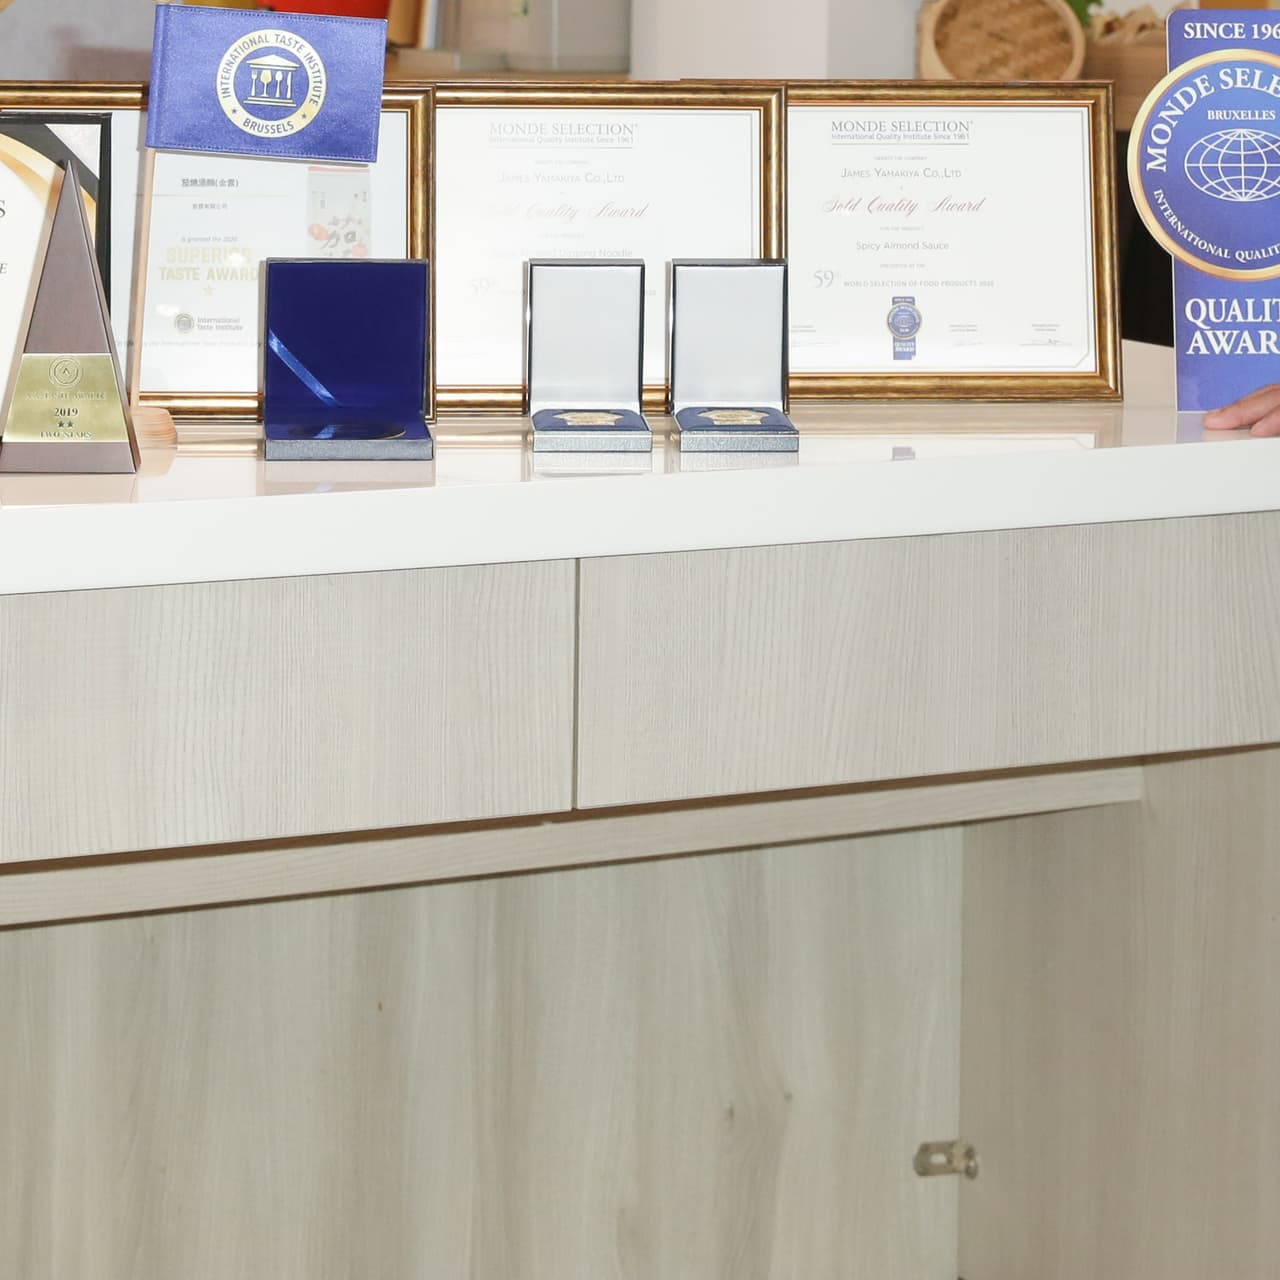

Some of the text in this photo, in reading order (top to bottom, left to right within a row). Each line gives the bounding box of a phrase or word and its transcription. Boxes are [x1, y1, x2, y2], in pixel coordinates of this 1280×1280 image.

[1183, 22, 1246, 40] SINCE
[220, 33, 323, 105] INTERNATIONAL TASTE INSTITUTE
[1207, 109, 1276, 121] BRUXELLES
[243, 118, 294, 134] BRUSSELS
[489, 122, 634, 135] MONDE SELECTION
[831, 121, 969, 132] MONDE SELECTION
[1146, 74, 1216, 173] MONDE
[876, 133, 902, 142] Quality
[866, 196, 919, 218] Quality
[927, 195, 987, 212] Award
[1153, 188, 1231, 259] INTERNATIONAL
[856, 240, 950, 252] Spicy Almond Sauce
[160, 266, 200, 281] TASTE
[55, 408, 79, 416] 2019
